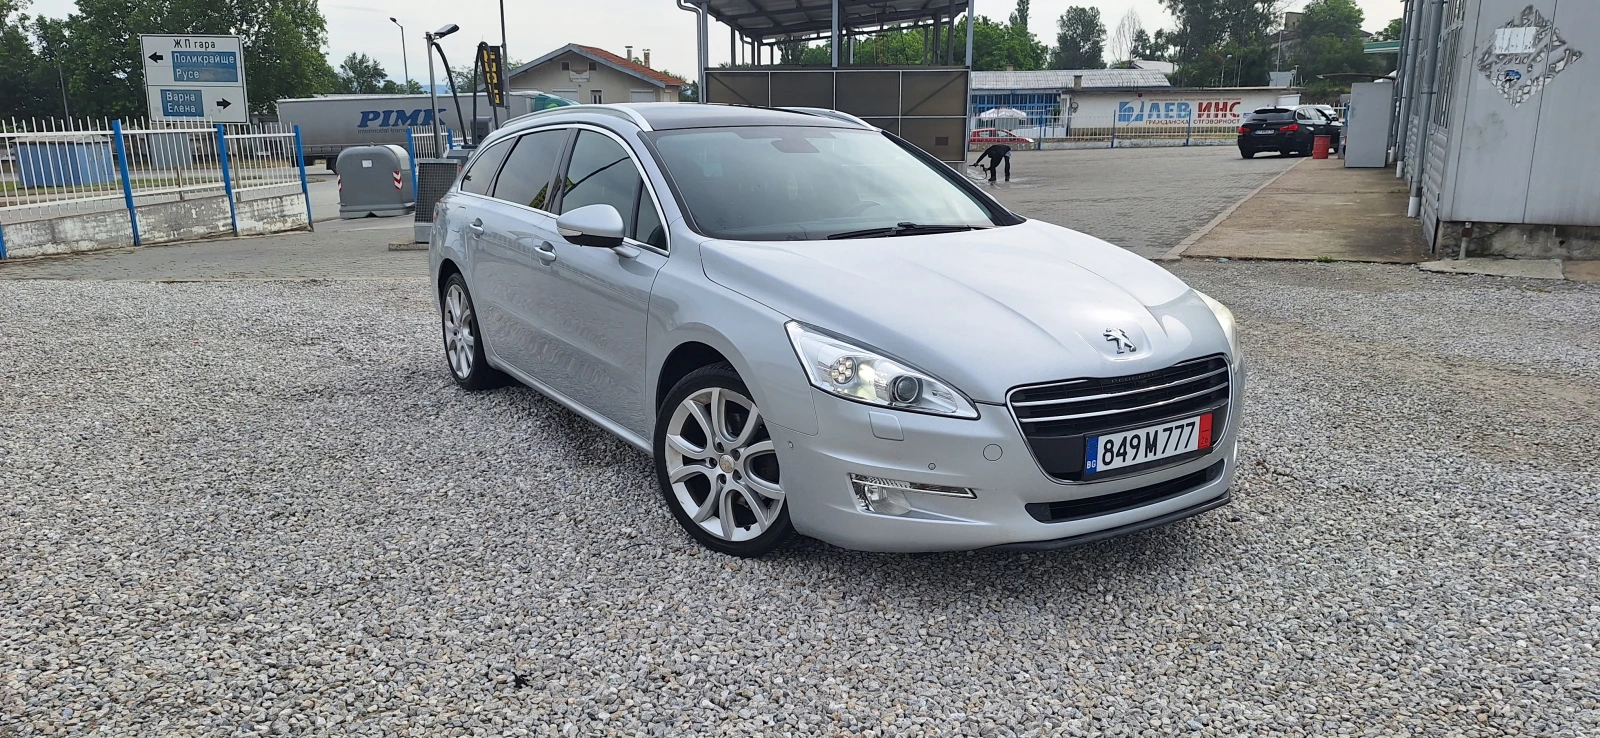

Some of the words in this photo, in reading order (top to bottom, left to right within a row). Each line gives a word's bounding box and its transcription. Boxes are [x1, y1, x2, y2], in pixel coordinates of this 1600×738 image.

[194, 41, 216, 51] гара
[174, 53, 235, 66] Поликрайще
[176, 69, 200, 80] Русе
[166, 91, 196, 103] Варна
[167, 103, 196, 113] Елена
[1147, 102, 1191, 119] ЛЕВ
[1197, 102, 1241, 118] ИНС
[357, 108, 447, 128] PIMK
[1101, 421, 1196, 466] 849M777
[1086, 459, 1097, 469] BG
